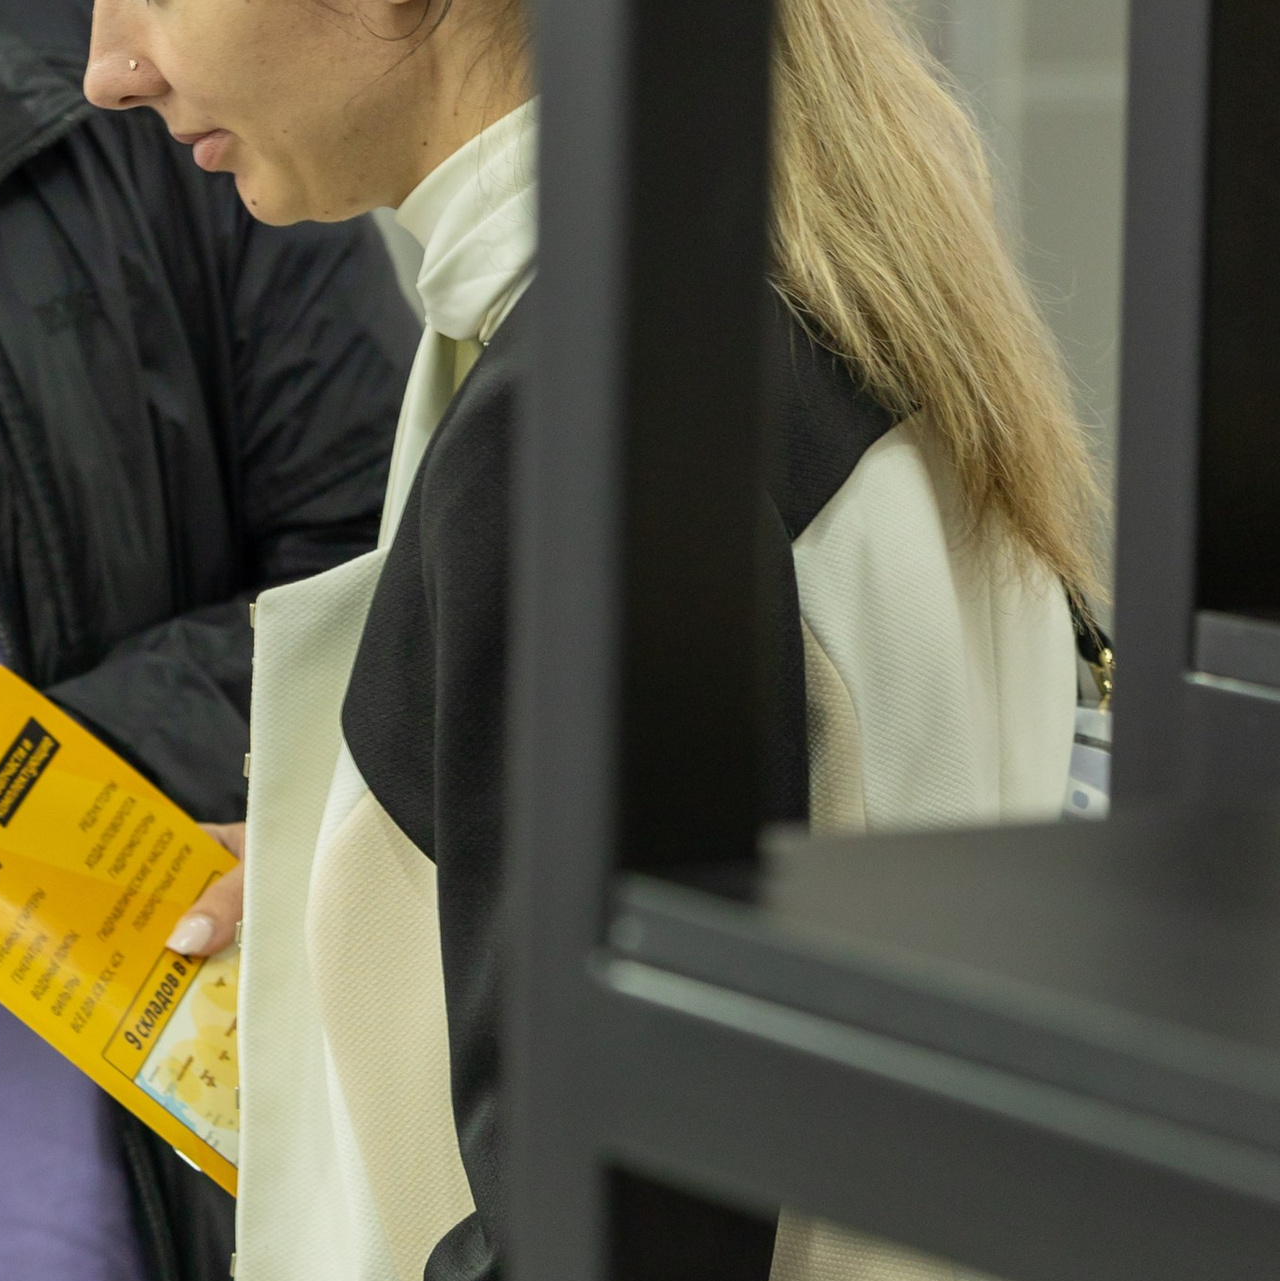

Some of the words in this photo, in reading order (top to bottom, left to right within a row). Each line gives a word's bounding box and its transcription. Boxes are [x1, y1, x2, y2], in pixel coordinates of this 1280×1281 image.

[124, 1031, 142, 1051] 9
[135, 973, 180, 1038] складов
[172, 961, 187, 976] в
